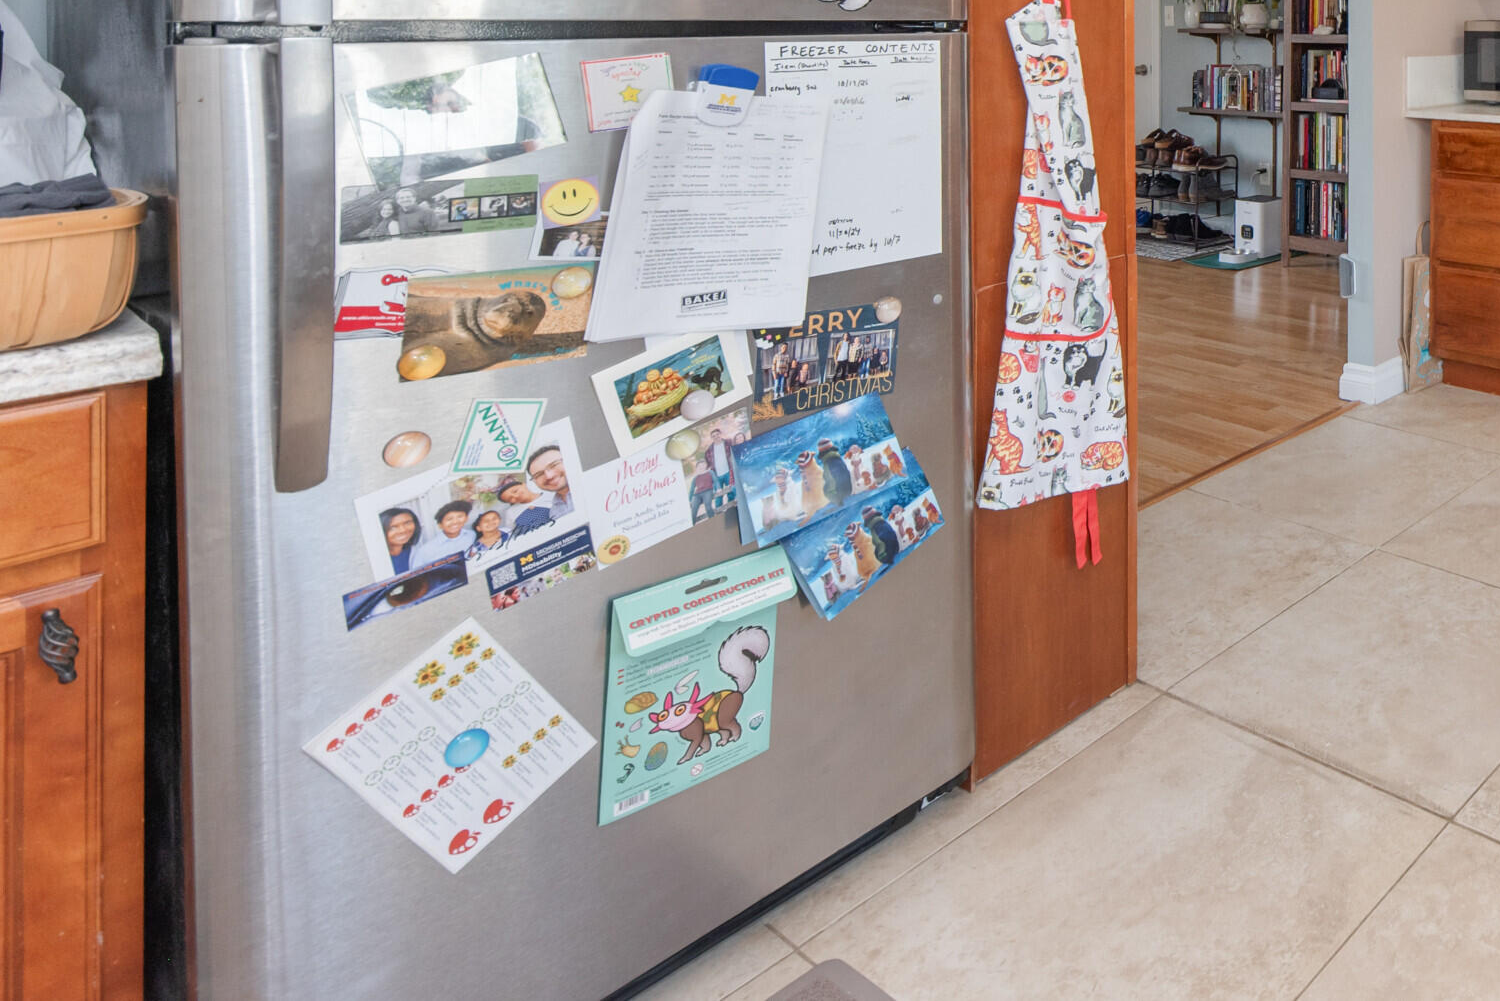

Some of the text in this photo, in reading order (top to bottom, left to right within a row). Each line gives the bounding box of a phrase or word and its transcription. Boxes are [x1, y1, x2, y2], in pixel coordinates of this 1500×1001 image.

[779, 42, 936, 58] FREEZER CONTENTS
[793, 373, 893, 411] CHRISTMAS
[616, 453, 663, 485] Merry
[604, 470, 678, 513] Christmas
[629, 605, 681, 631] CRYPTID
[682, 574, 767, 611] CONSTRUCTION
[767, 566, 787, 581] KIT
